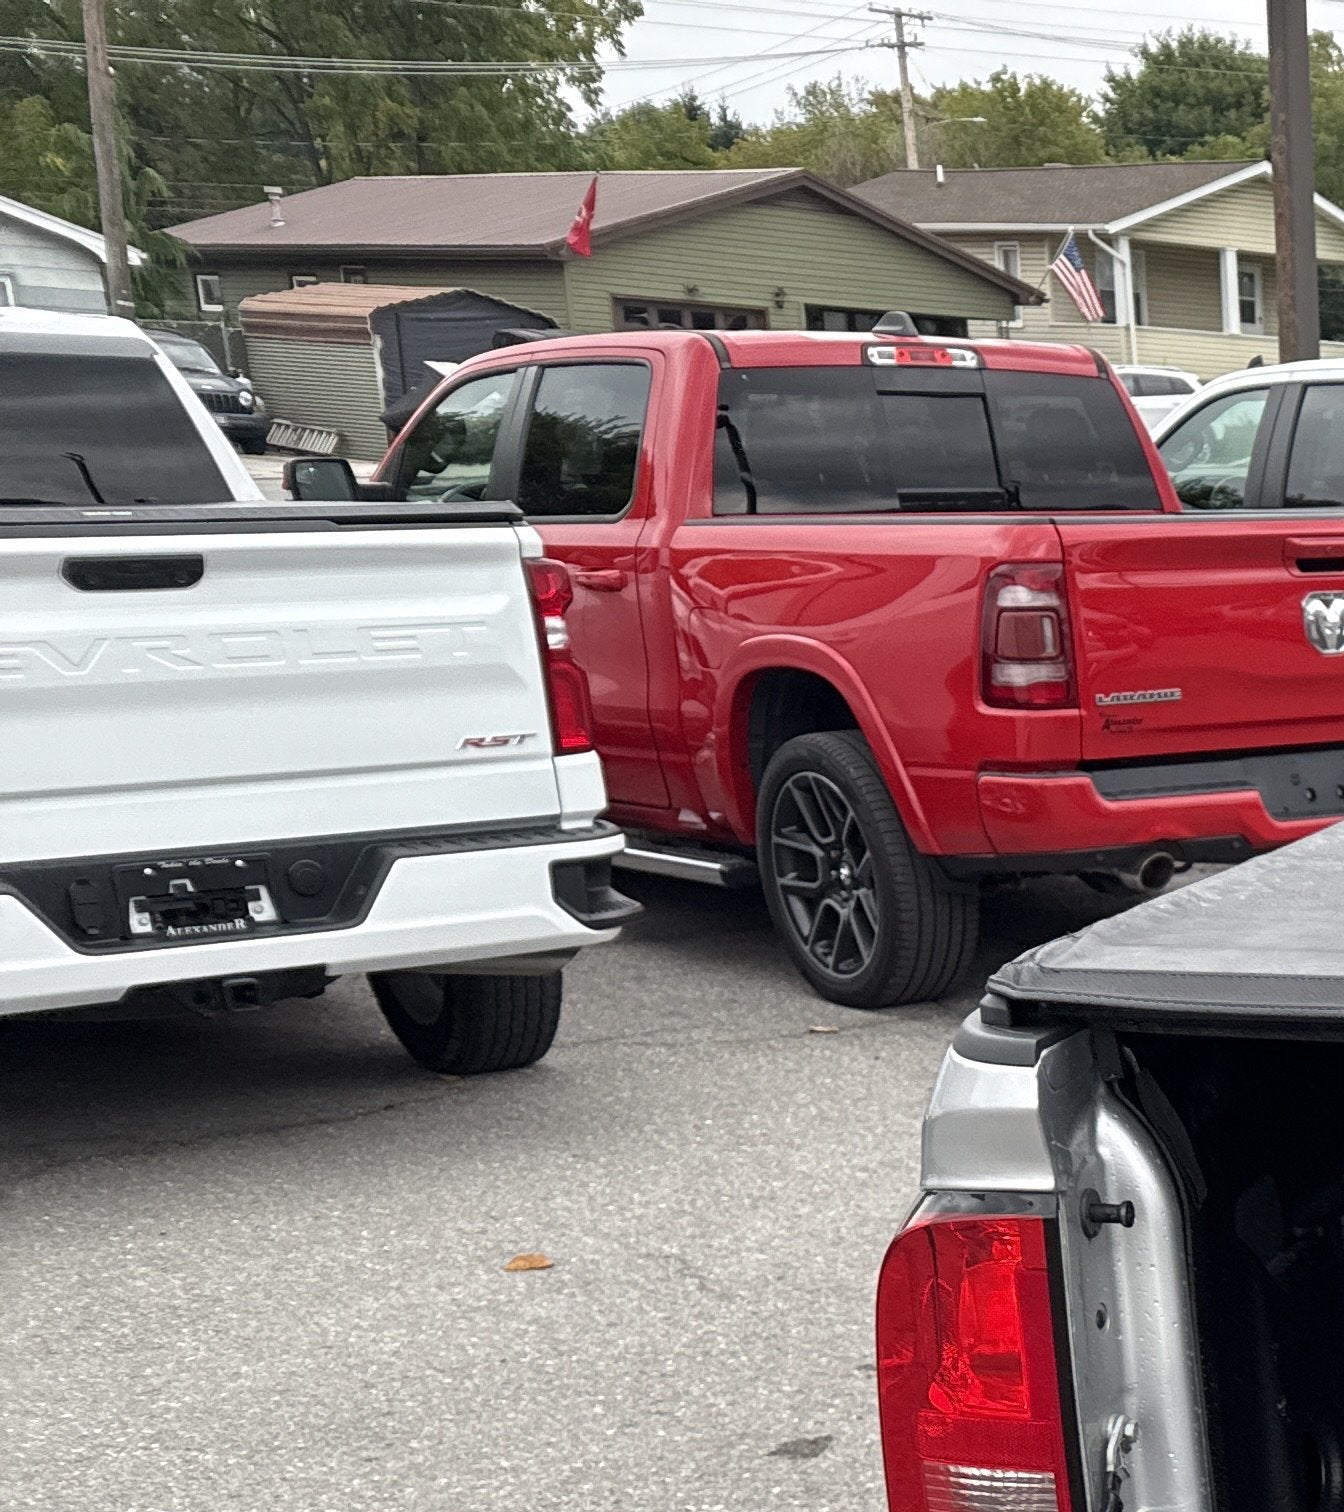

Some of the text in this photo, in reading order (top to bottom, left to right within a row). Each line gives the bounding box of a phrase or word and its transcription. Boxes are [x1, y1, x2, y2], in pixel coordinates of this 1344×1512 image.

[1095, 687, 1182, 706] LARAMIE
[455, 732, 537, 751] RST
[166, 917, 248, 937] ALEXANDER
